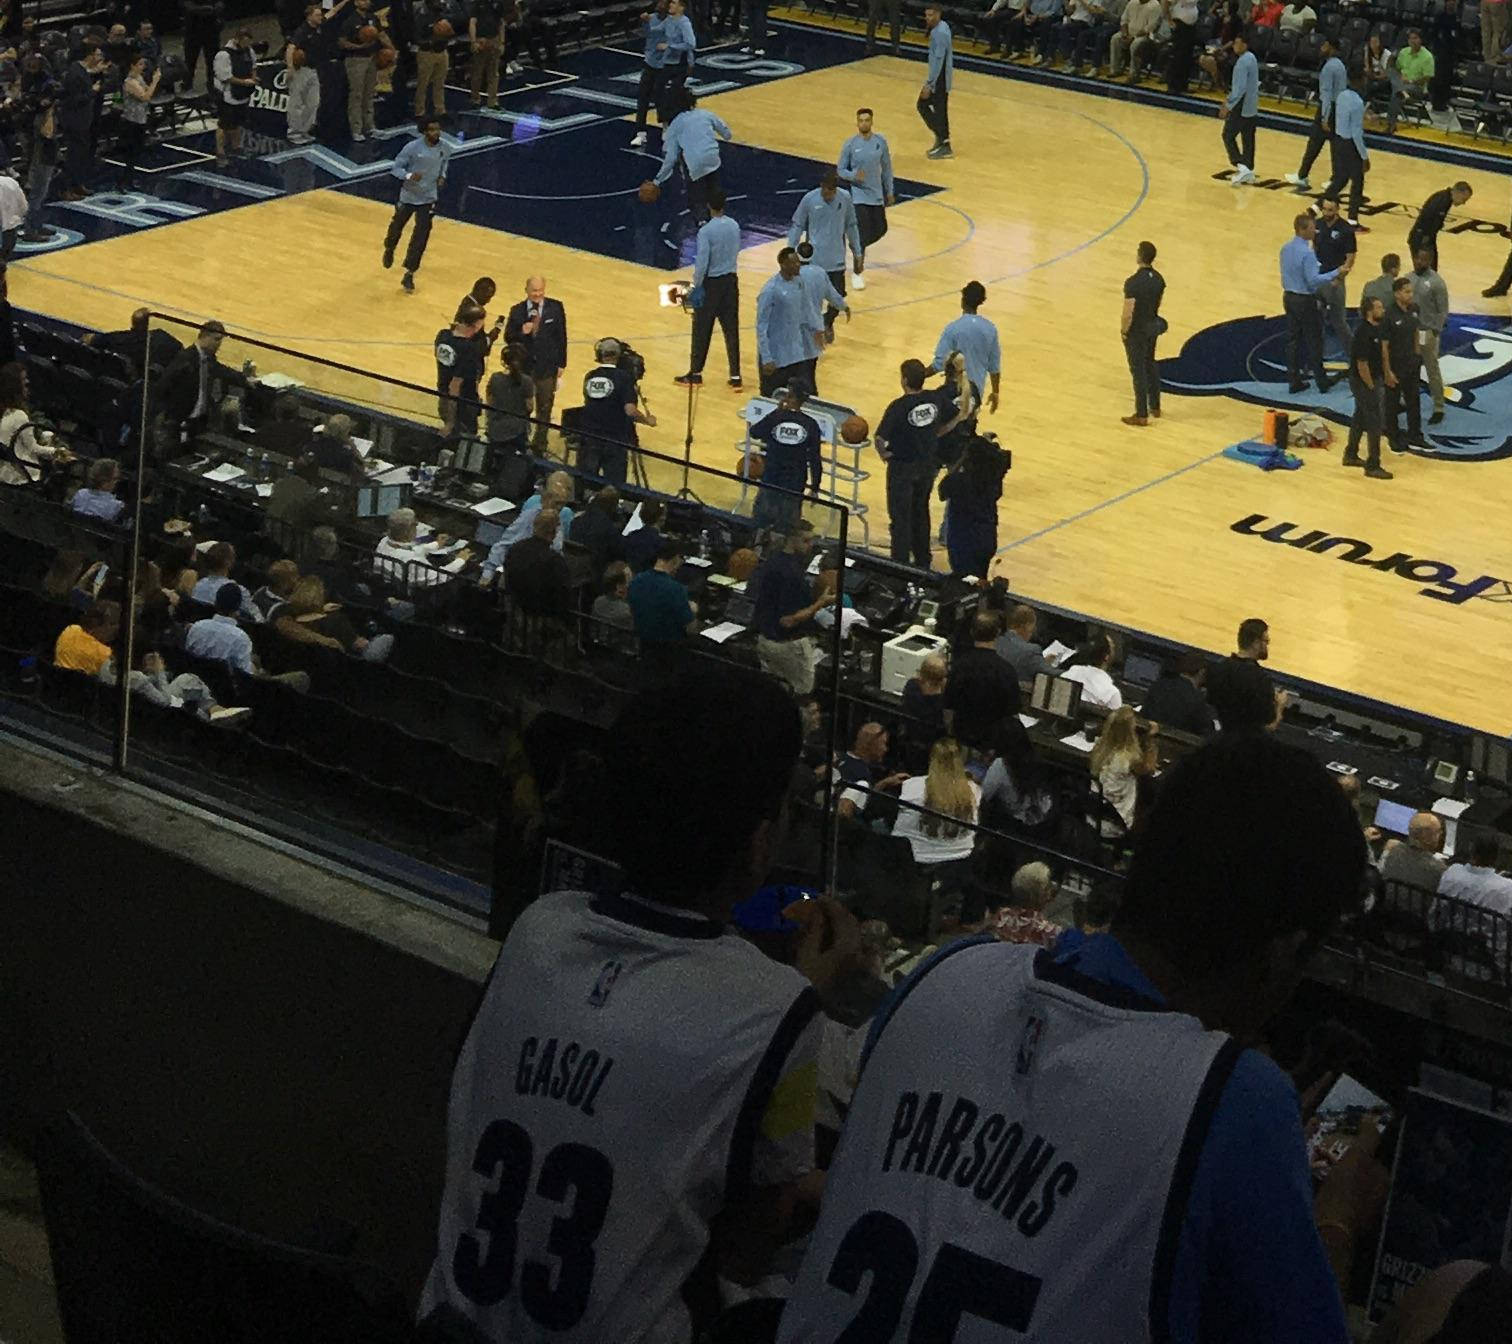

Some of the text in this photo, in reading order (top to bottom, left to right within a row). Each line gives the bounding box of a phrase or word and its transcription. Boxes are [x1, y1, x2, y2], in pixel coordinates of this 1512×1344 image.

[515, 1036, 613, 1117] GASOL
[453, 1118, 614, 1331] 33
[882, 1091, 1078, 1238] PARSONS
